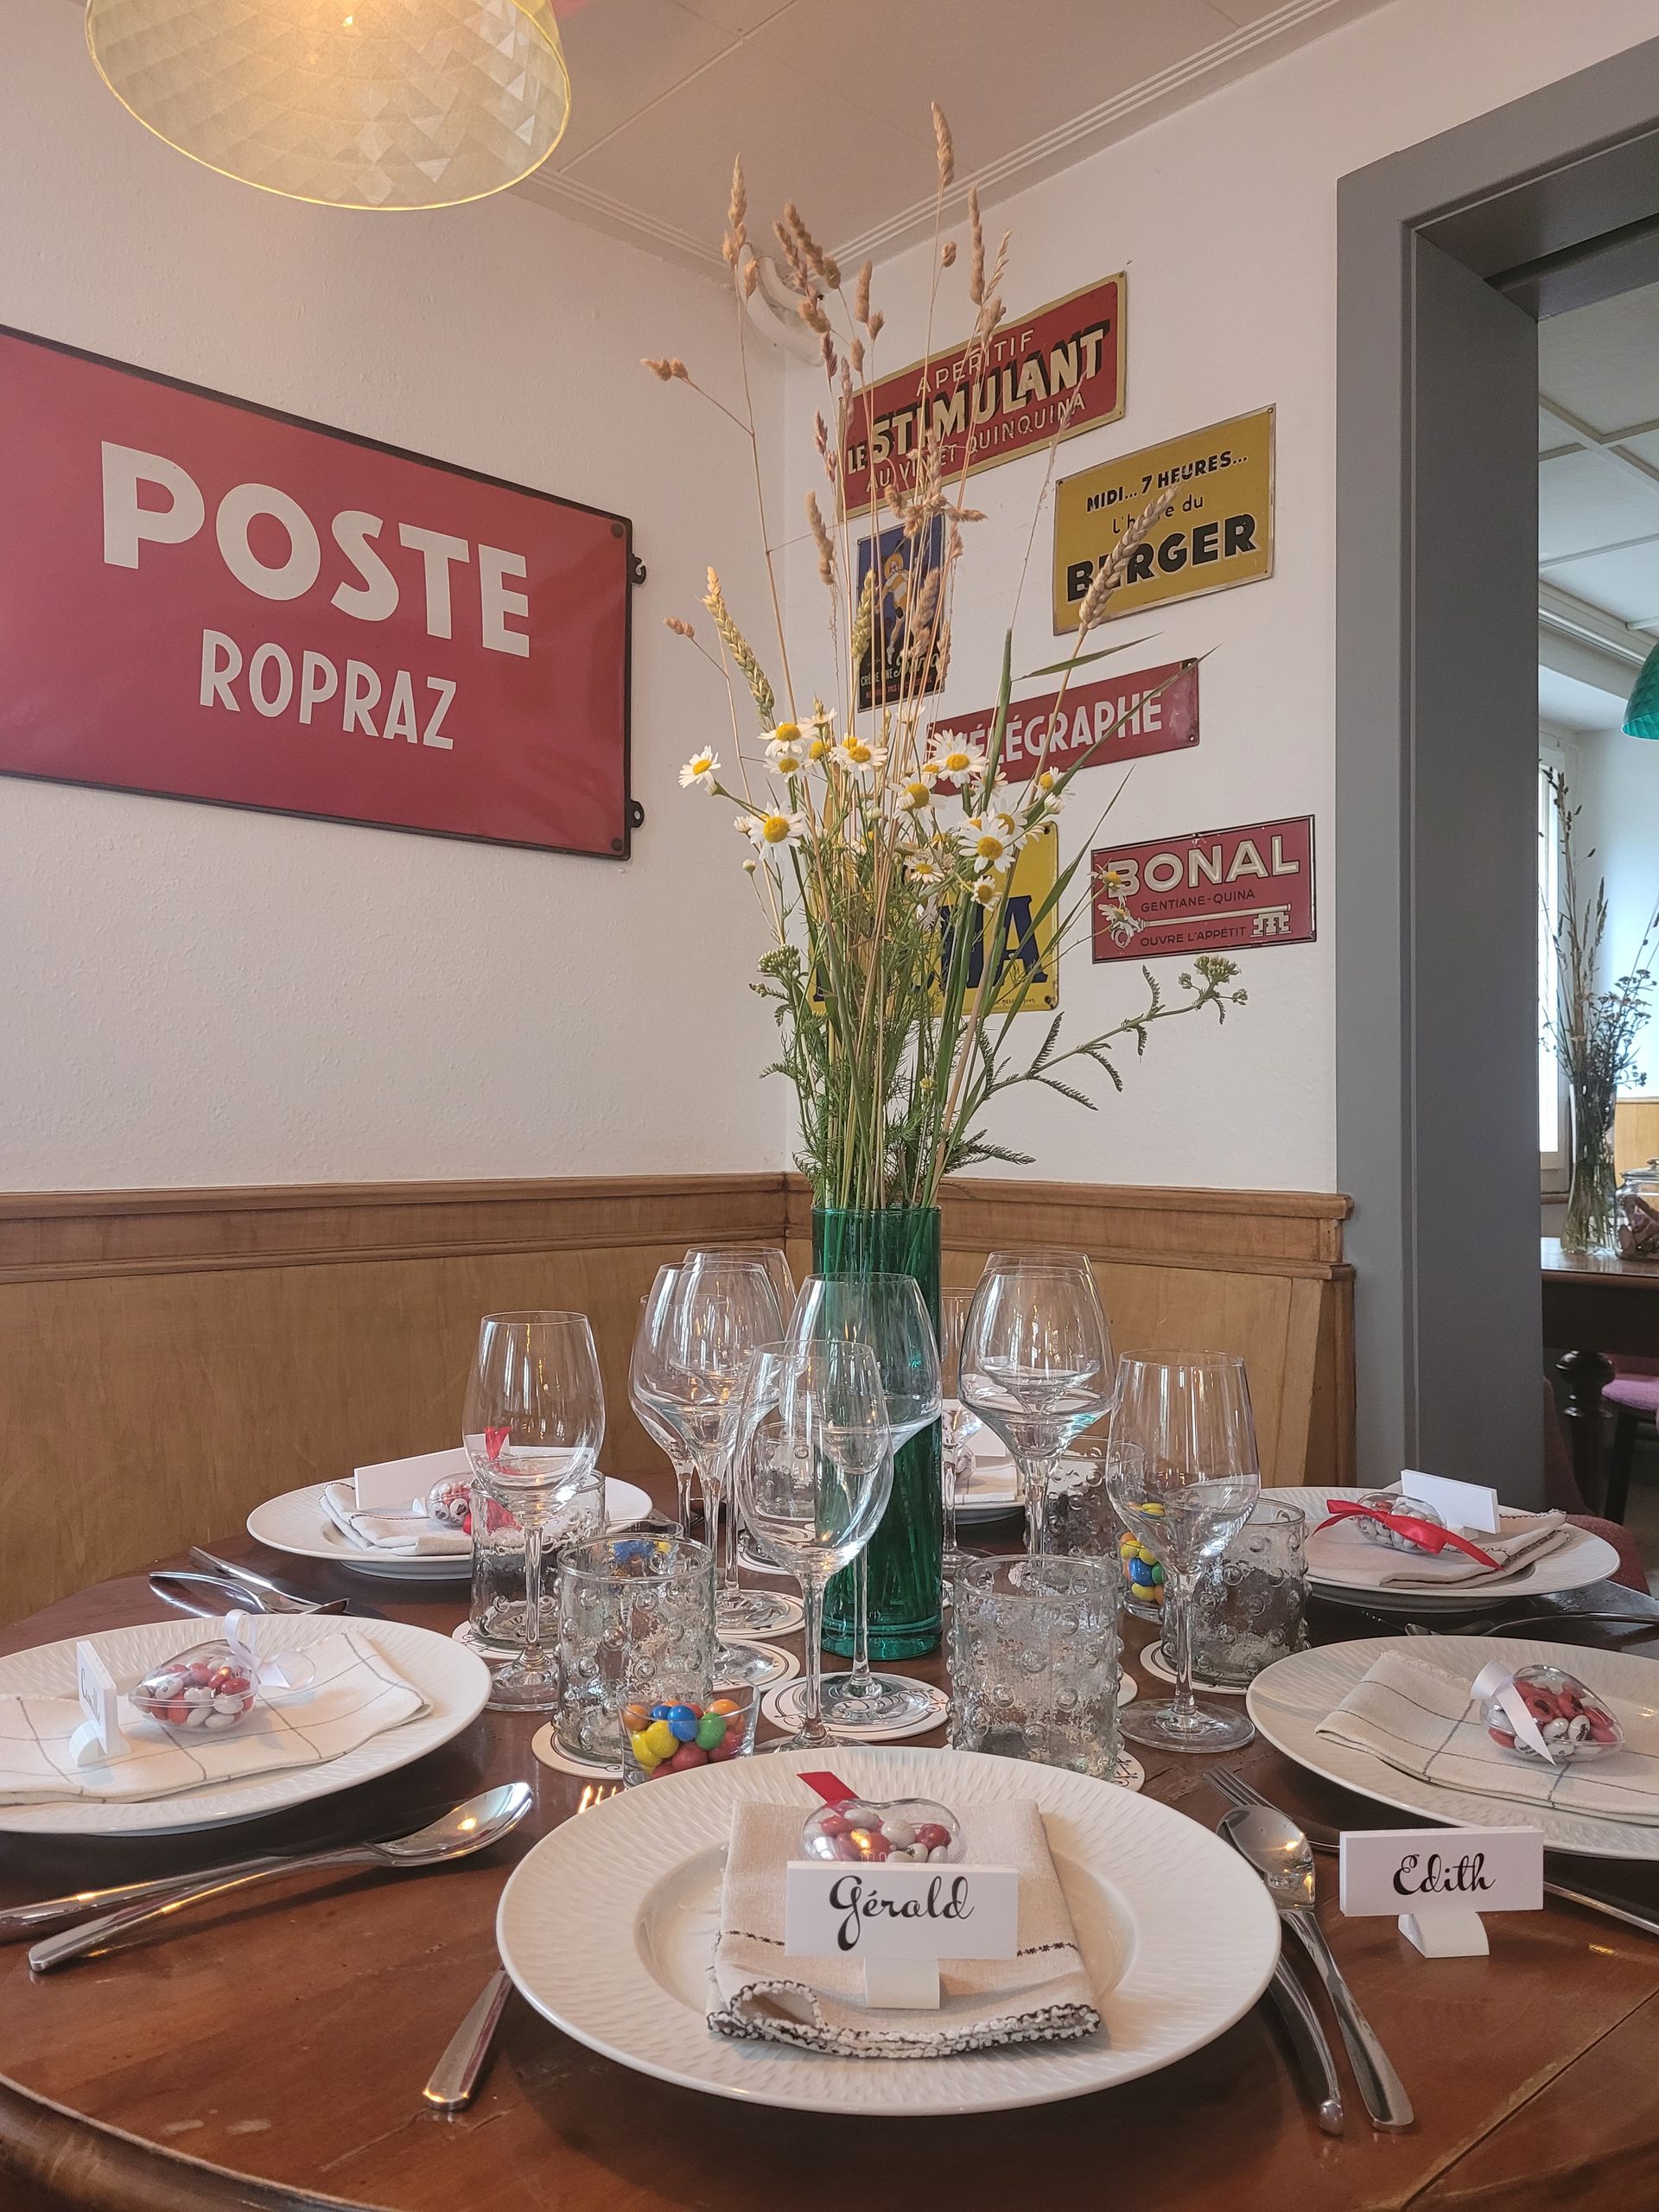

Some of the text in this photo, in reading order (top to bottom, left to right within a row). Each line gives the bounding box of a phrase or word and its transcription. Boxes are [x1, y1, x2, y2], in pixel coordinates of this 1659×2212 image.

[848, 325, 1107, 474] LE STIMULANT
[866, 467, 890, 493] AU
[969, 393, 1085, 454] QUINQUINA
[1141, 475, 1153, 494] 7
[1182, 494, 1204, 512] du
[101, 441, 530, 658] POSTE
[200, 629, 457, 750] ROPRAZ
[1108, 835, 1300, 899] BONAL
[1140, 934, 1184, 947] OUVRE
[1393, 1853, 1497, 1896] Edith
[829, 1875, 976, 1951] Gérald
